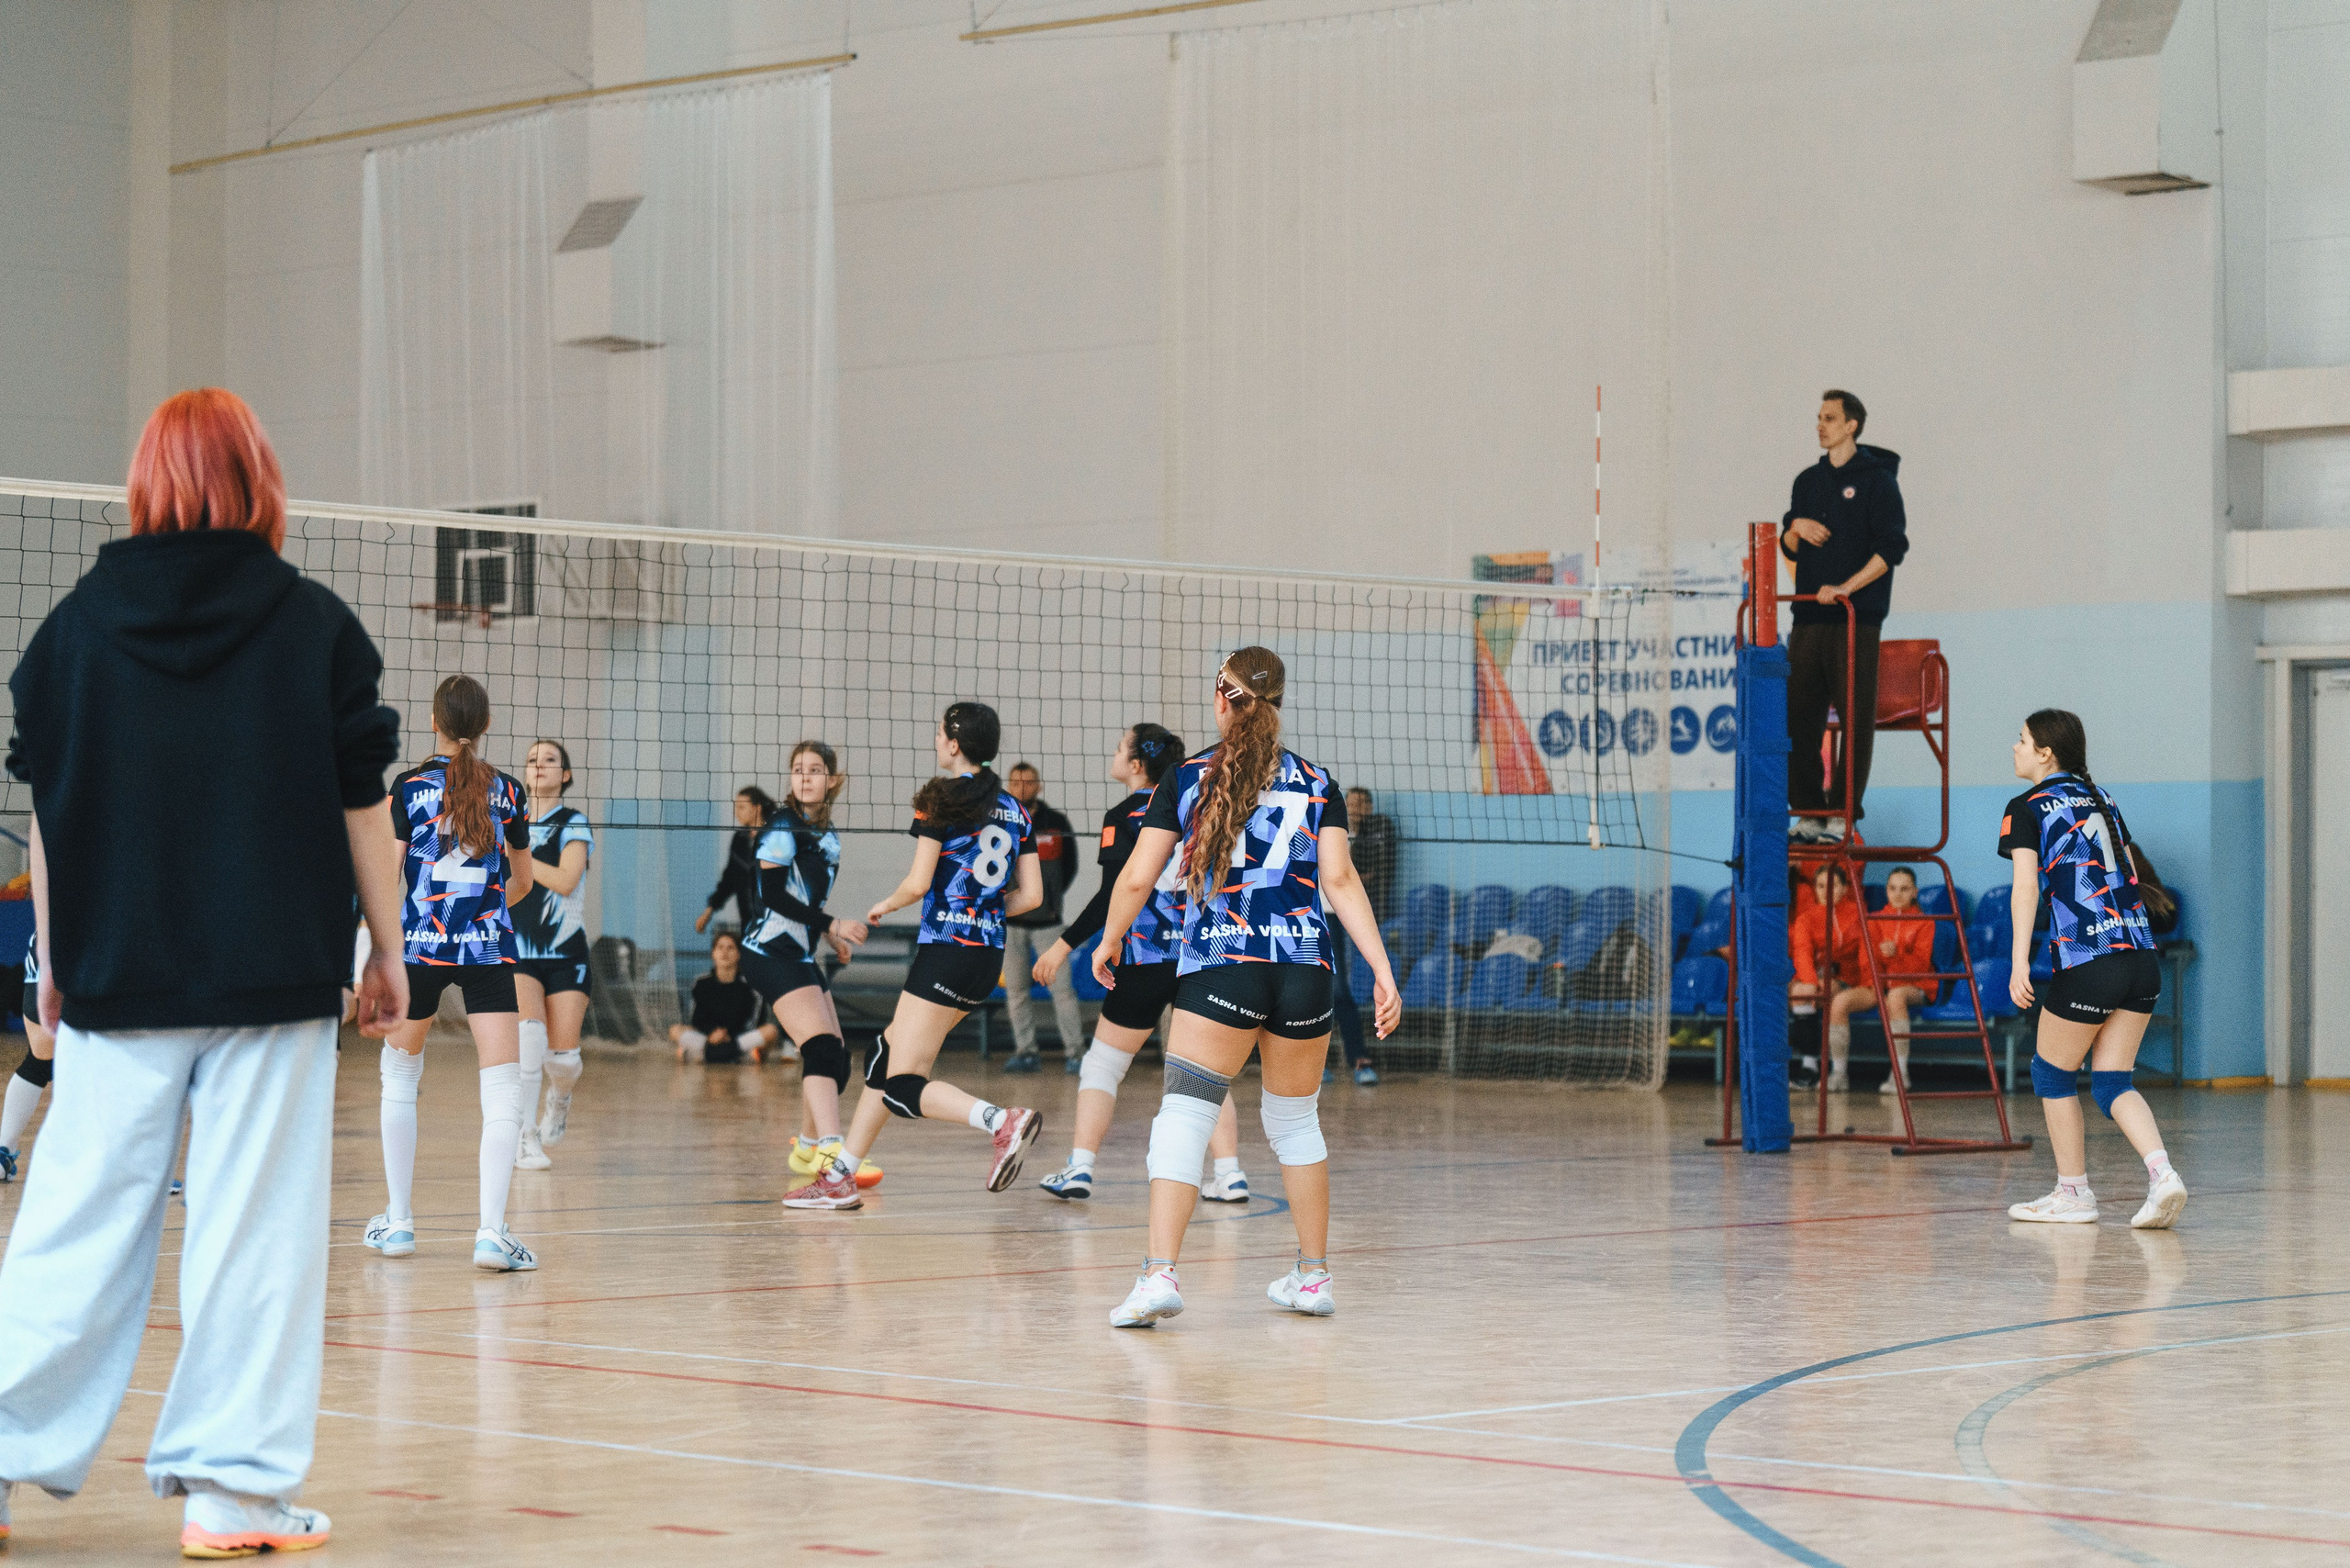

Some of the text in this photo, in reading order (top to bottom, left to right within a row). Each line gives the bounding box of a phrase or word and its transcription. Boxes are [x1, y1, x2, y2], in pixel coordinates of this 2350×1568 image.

[1561, 667, 1739, 695] СОРЕВНОВАНИ
[2081, 812, 2118, 873] 1
[973, 824, 1013, 887] 8
[936, 911, 977, 926] SASHA
[2086, 916, 2125, 936] SASHA
[405, 929, 501, 944] SASHA VOLLEY
[1162, 930, 1185, 941] SAS
[1200, 924, 1321, 940] SASHA VOLLEY
[576, 964, 587, 984] 7
[934, 982, 957, 1000] SASHA
[1207, 994, 1269, 1021] SASHA VOLLEY
[2069, 1002, 2100, 1014] SASHA
